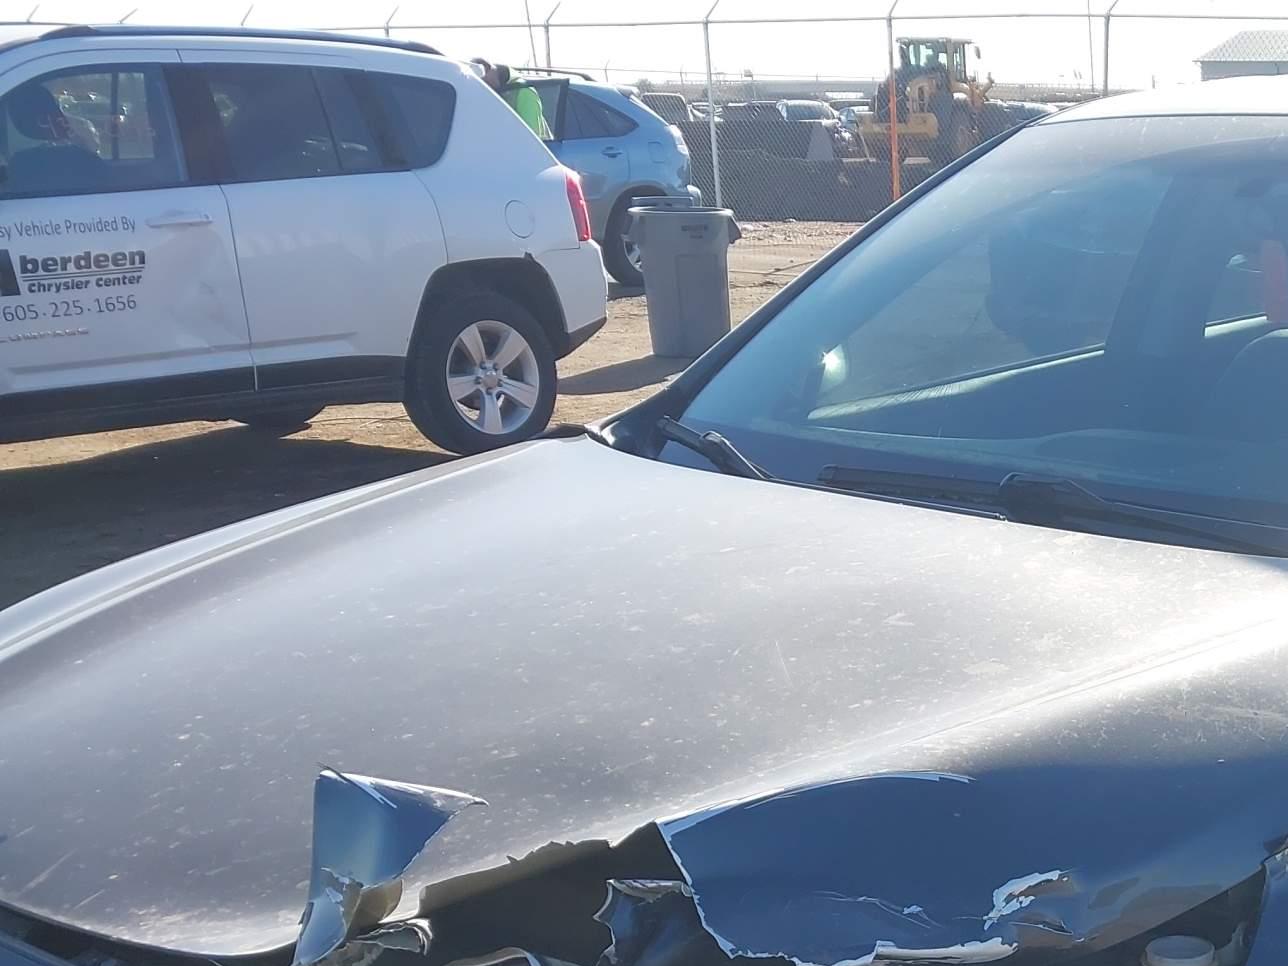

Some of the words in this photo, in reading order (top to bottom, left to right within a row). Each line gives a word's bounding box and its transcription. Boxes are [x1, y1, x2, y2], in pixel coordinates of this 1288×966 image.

[14, 219, 62, 237] Vehicle
[64, 216, 119, 234] Provided
[120, 216, 136, 234] By
